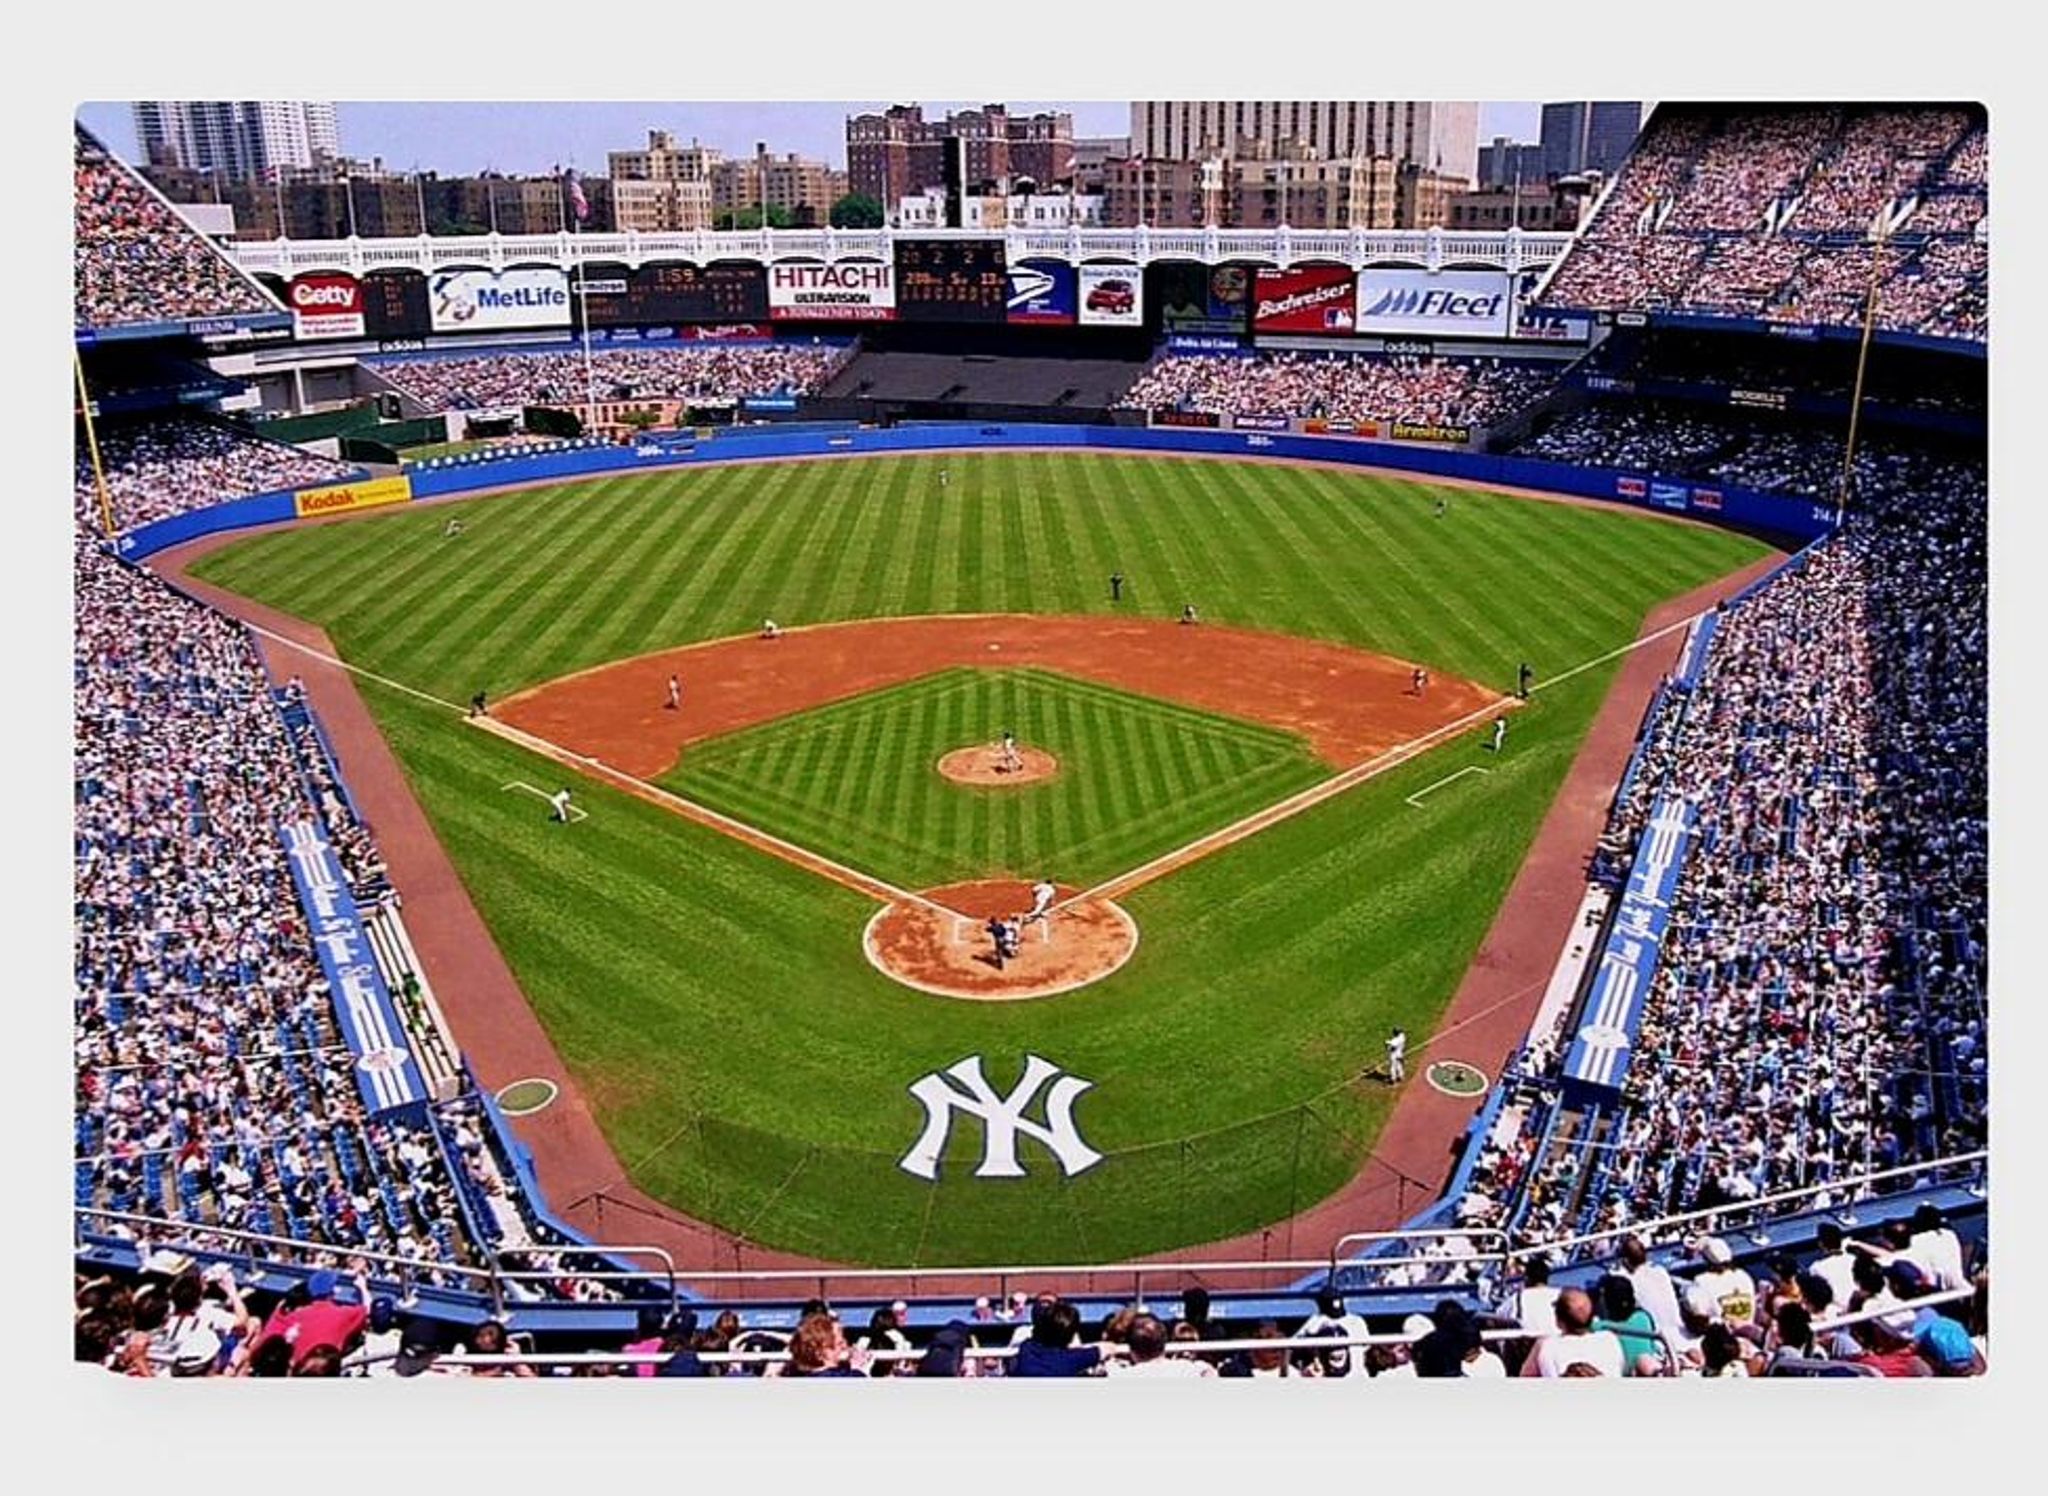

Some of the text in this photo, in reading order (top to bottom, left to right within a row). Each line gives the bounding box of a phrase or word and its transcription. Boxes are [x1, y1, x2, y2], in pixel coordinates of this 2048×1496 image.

[774, 267, 889, 288] HITACHI
[293, 283, 355, 307] Getty
[477, 287, 566, 307] MetLife
[794, 292, 871, 303] ULTRAVISION
[1254, 283, 1352, 319] Budweiser
[1417, 290, 1503, 316] Fleet
[381, 340, 424, 352] adidas
[1384, 342, 1431, 354] adidas
[1393, 424, 1468, 440] Armitron
[301, 488, 355, 511] Kodak
